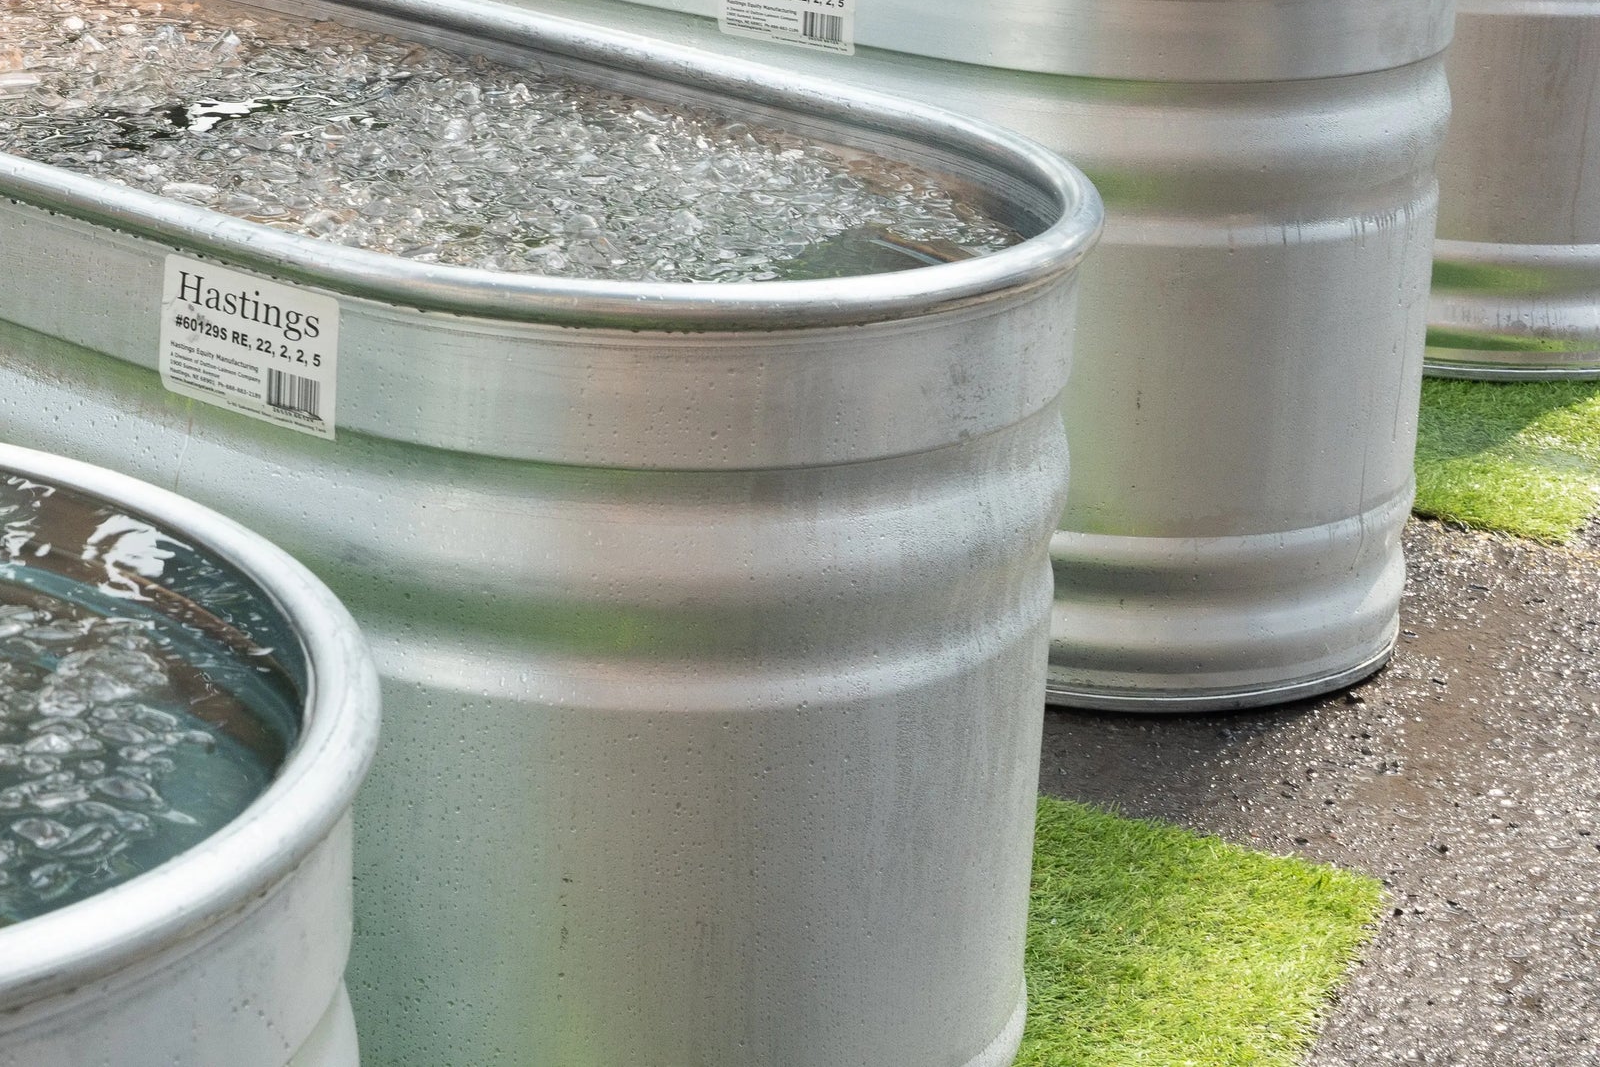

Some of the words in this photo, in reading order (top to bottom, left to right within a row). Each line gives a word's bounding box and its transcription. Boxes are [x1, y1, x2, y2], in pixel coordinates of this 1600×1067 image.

[176, 270, 320, 342] Hastings
[170, 340, 196, 354] Hastings
[196, 347, 214, 360] Equity
[216, 353, 259, 374] Manufacturing
[175, 313, 228, 341] #60129S
[231, 330, 252, 351] RE,
[256, 338, 276, 358] 22,
[279, 344, 292, 362] 2,
[296, 349, 308, 367] 2,
[312, 353, 322, 368] 5
